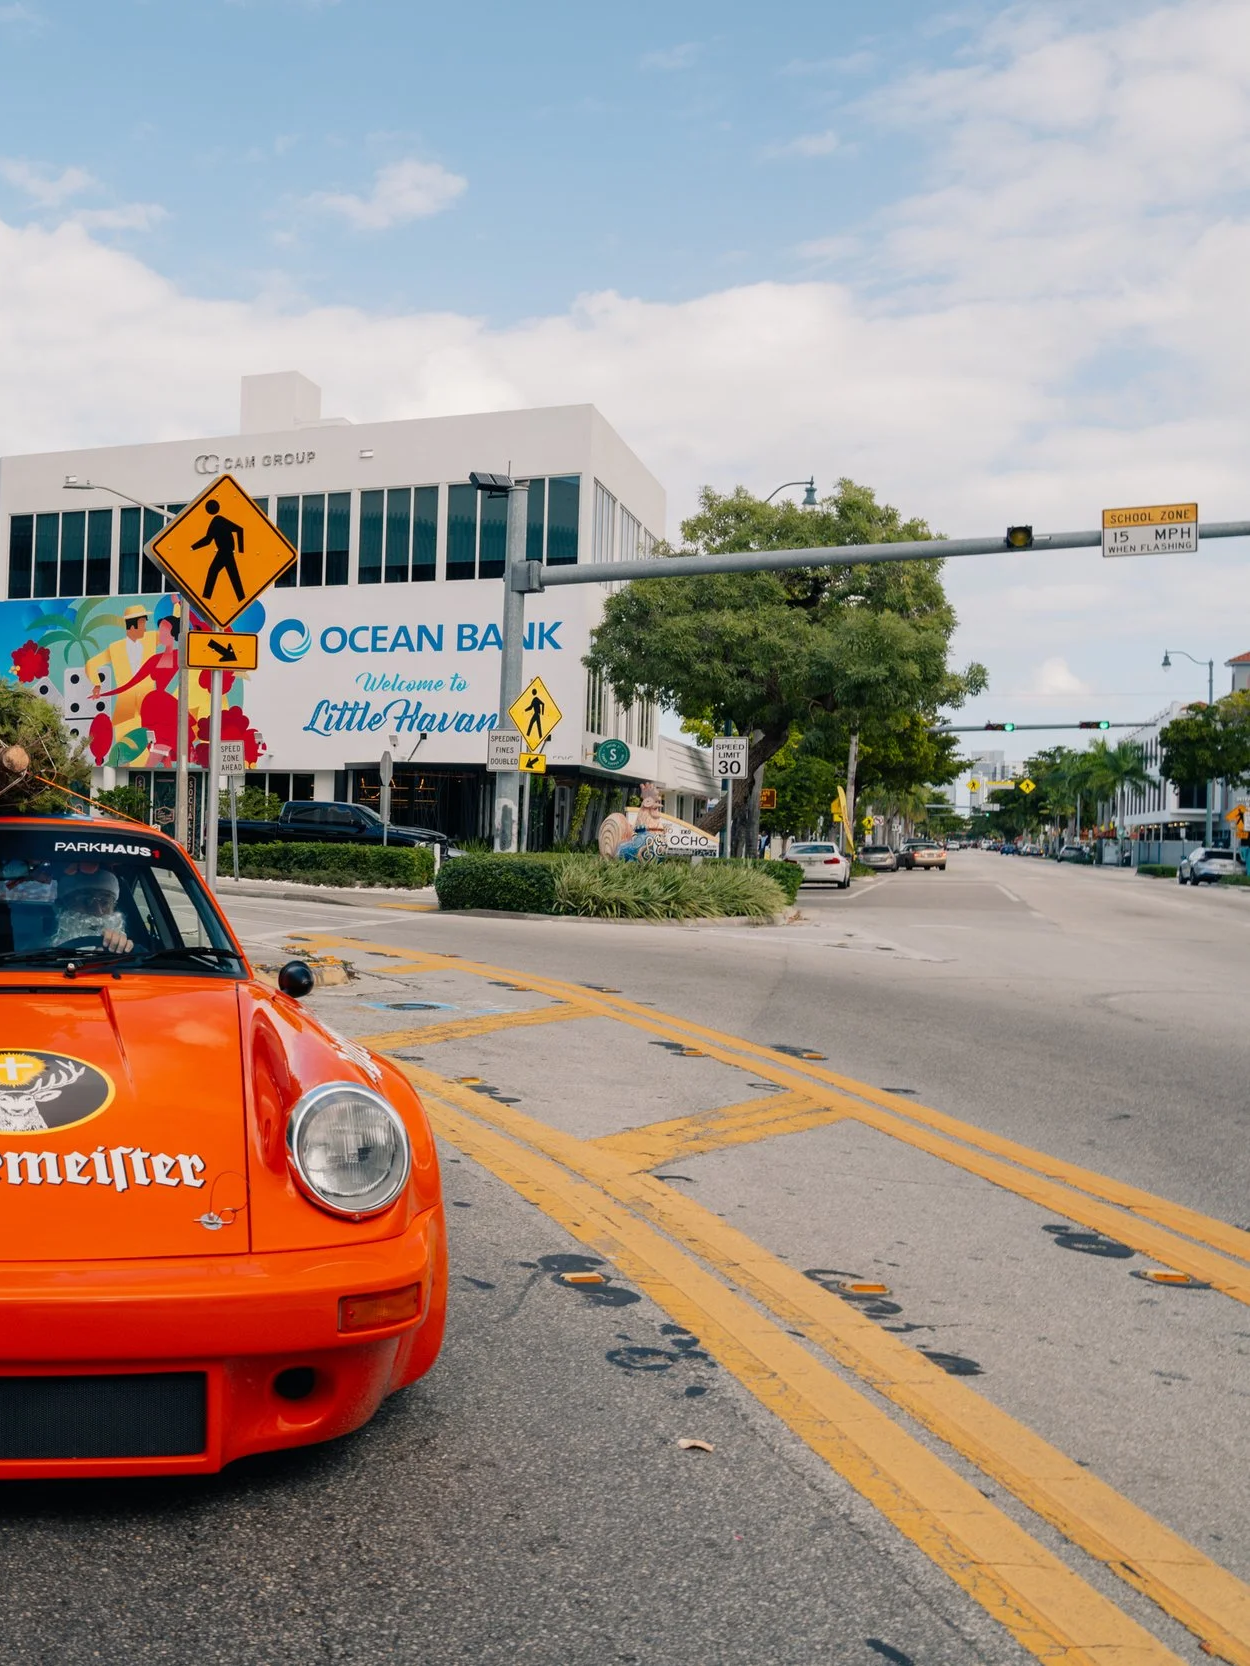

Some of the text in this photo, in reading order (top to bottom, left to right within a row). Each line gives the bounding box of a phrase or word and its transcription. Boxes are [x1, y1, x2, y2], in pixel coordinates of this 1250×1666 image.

[224, 456, 256, 470] CAM
[262, 451, 316, 467] GROUP
[1110, 508, 1191, 525] SCHOOL ZONE
[1113, 527, 1191, 544] 15 MPH
[1108, 541, 1192, 554] WHEN FLASHING
[319, 624, 444, 653] OCEAN
[354, 671, 470, 693] Welcome to
[302, 699, 500, 737] Little Havan
[490, 734, 520, 743] SPEEDING
[220, 745, 241, 753] SPEED
[495, 746, 515, 754] FINES
[715, 743, 745, 751] SPEED
[609, 748, 617, 761] S
[718, 751, 741, 759] LIMIT
[221, 763, 243, 771] AHEAD
[490, 757, 519, 766] DOUBLED
[718, 760, 741, 775] 30
[670, 835, 709, 847] OCHO
[54, 841, 161, 860] PARKHAUS1
